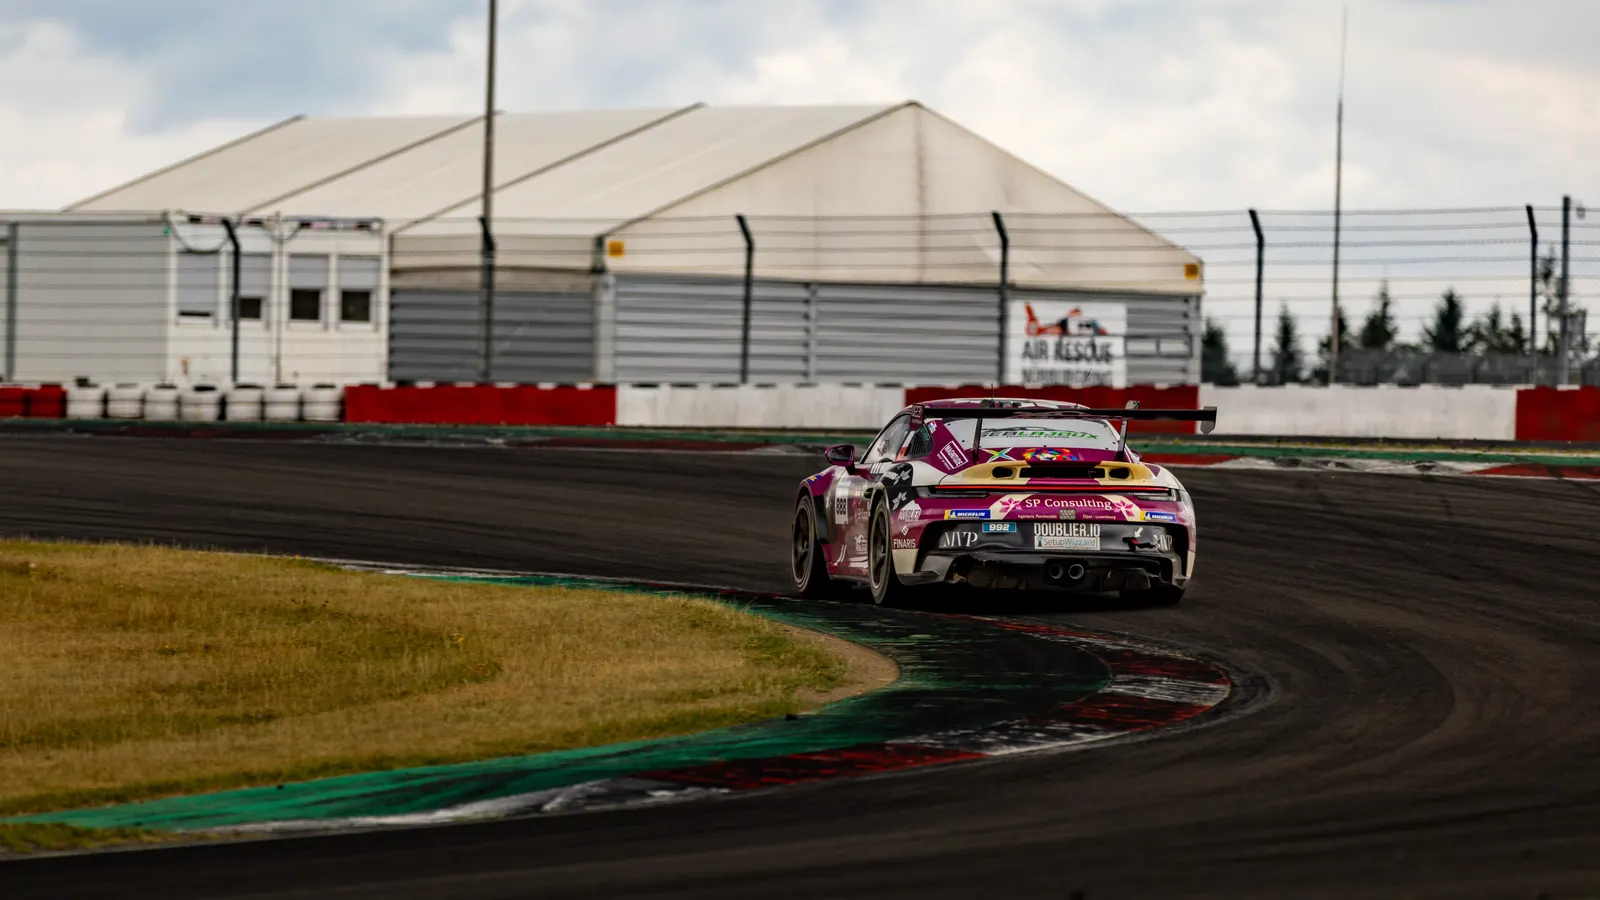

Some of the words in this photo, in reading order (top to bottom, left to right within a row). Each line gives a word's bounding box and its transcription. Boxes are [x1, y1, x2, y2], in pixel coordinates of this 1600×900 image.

[1023, 341, 1048, 360] AIR
[1055, 341, 1113, 362] RESCUE
[1025, 499, 1041, 508] SP
[1044, 498, 1112, 510] Consulting
[989, 523, 1010, 531] 992
[1033, 522, 1101, 537] DOUBLIER.IO
[893, 539, 916, 549] FINARIS
[943, 532, 978, 547] MVP
[1043, 538, 1096, 546] SetupWizzard
